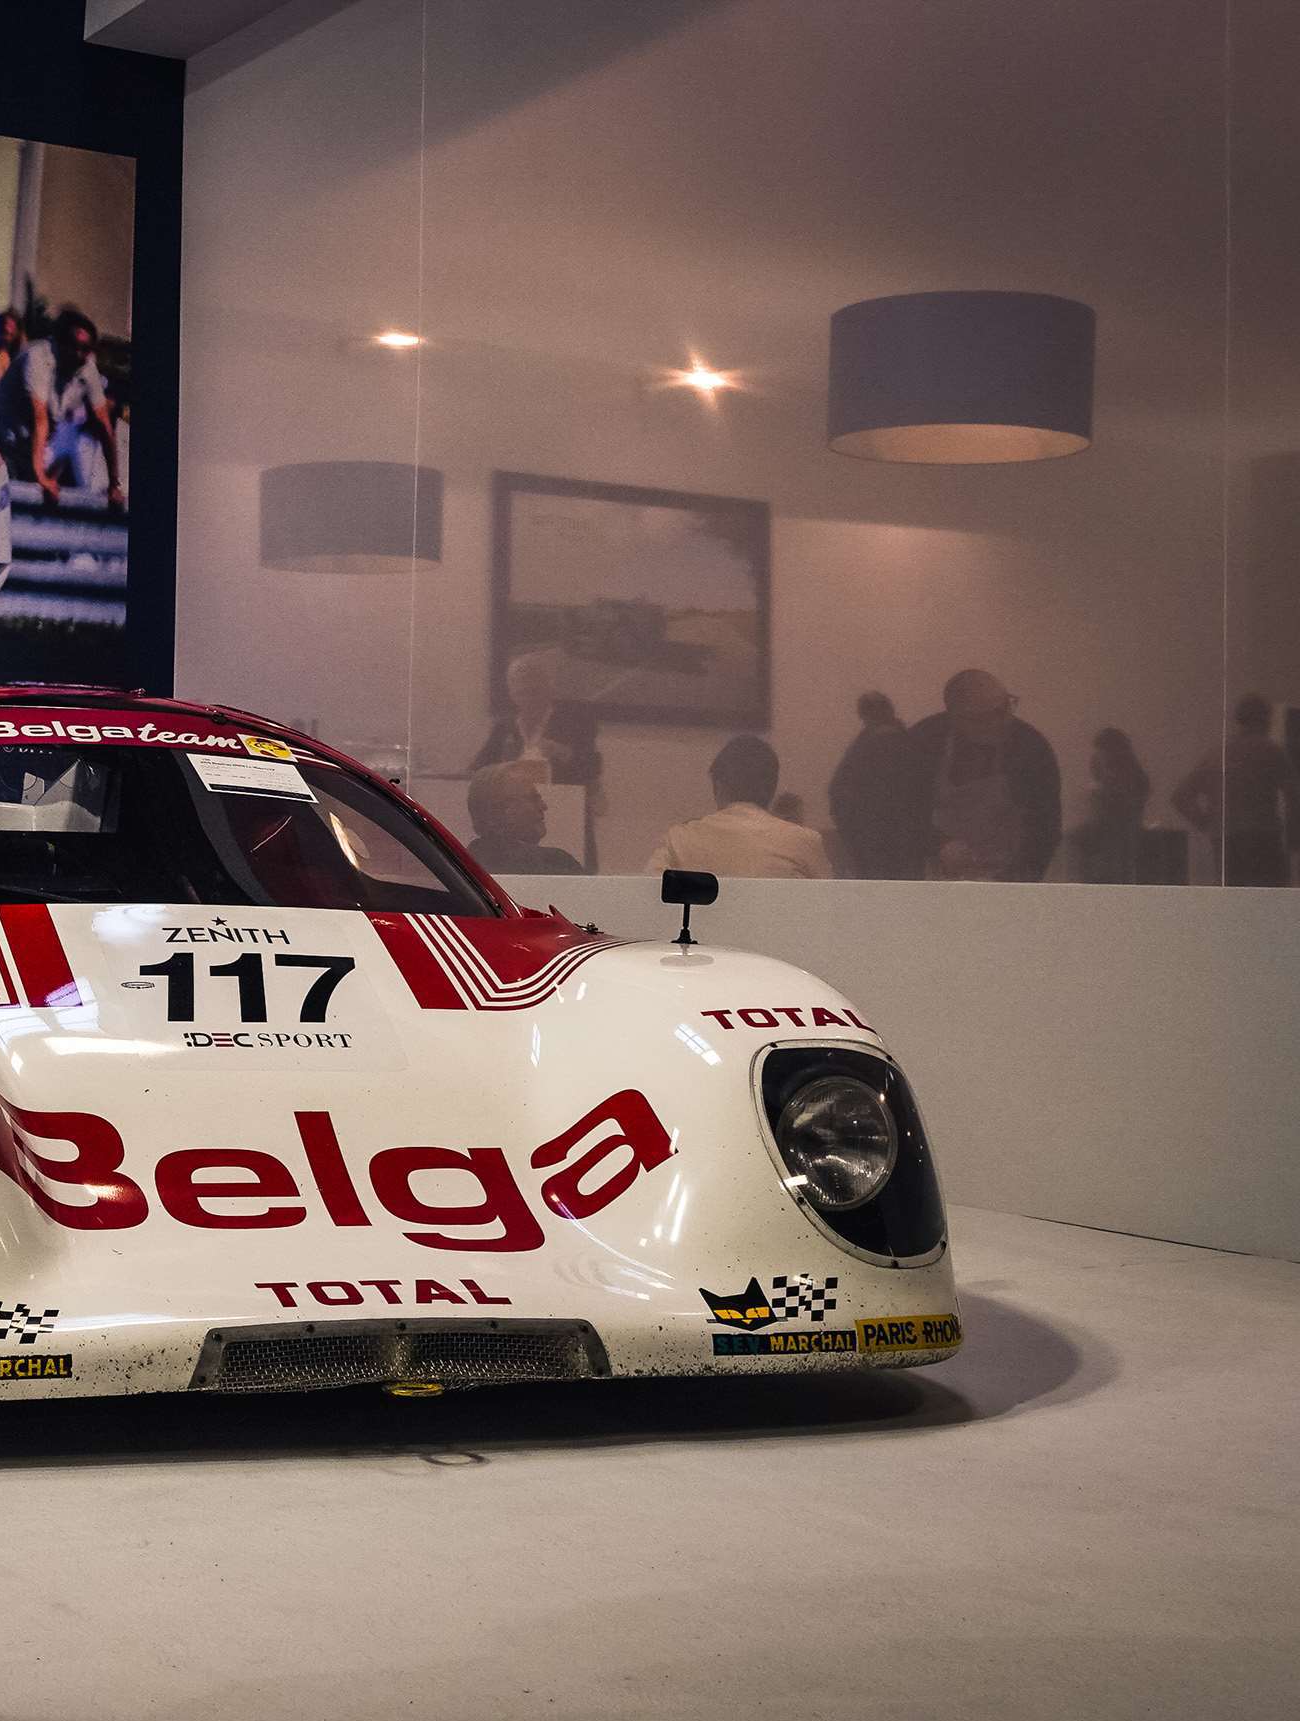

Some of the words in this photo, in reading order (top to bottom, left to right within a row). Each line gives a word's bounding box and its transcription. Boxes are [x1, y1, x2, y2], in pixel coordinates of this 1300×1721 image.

[136, 723, 241, 749] team
[162, 927, 291, 945] ZENITH
[140, 952, 355, 1023] 117
[700, 1007, 878, 1034] TOTAL
[257, 1033, 352, 1048] SPORT
[254, 1279, 512, 1307] TOTAL
[769, 1332, 854, 1352] MARCHAL
[863, 1321, 917, 1347] PARIS
